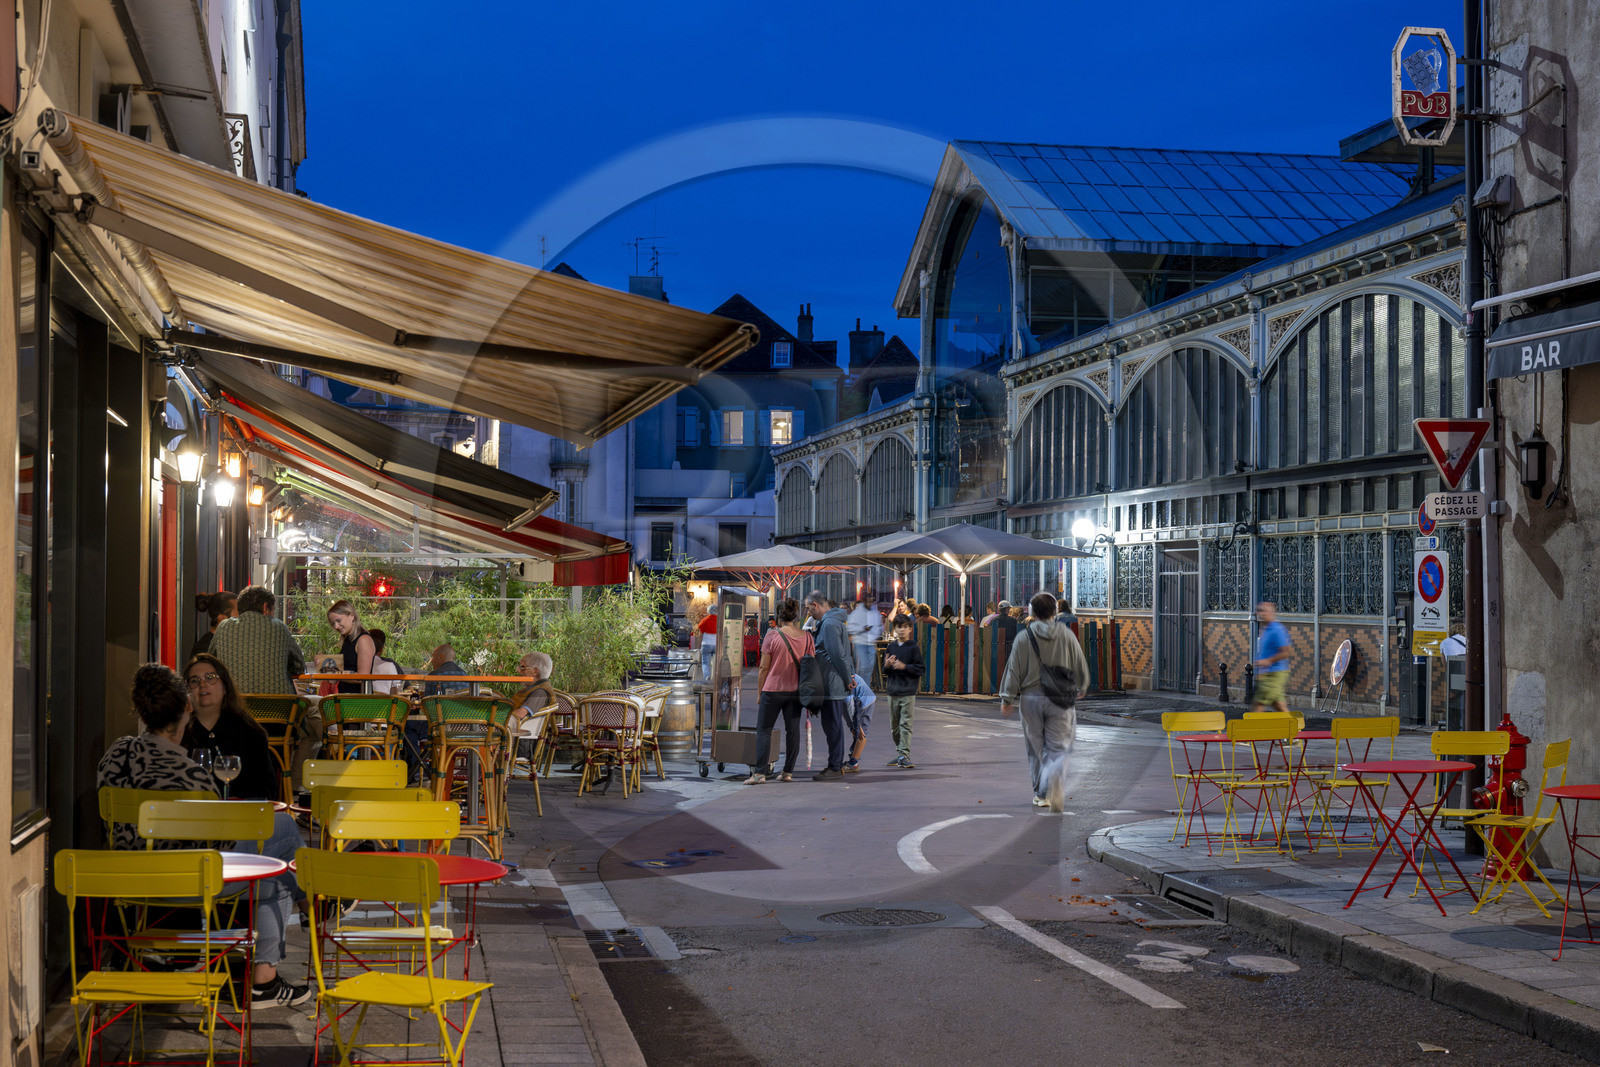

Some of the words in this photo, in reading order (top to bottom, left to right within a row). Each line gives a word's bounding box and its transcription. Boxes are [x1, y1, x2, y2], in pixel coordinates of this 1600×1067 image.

[1403, 93, 1447, 114] PUB
[1521, 340, 1560, 371] BAR
[1434, 495, 1463, 506] CÉDEZ
[1467, 495, 1478, 504] LE
[1435, 506, 1478, 516] PASSAGE
